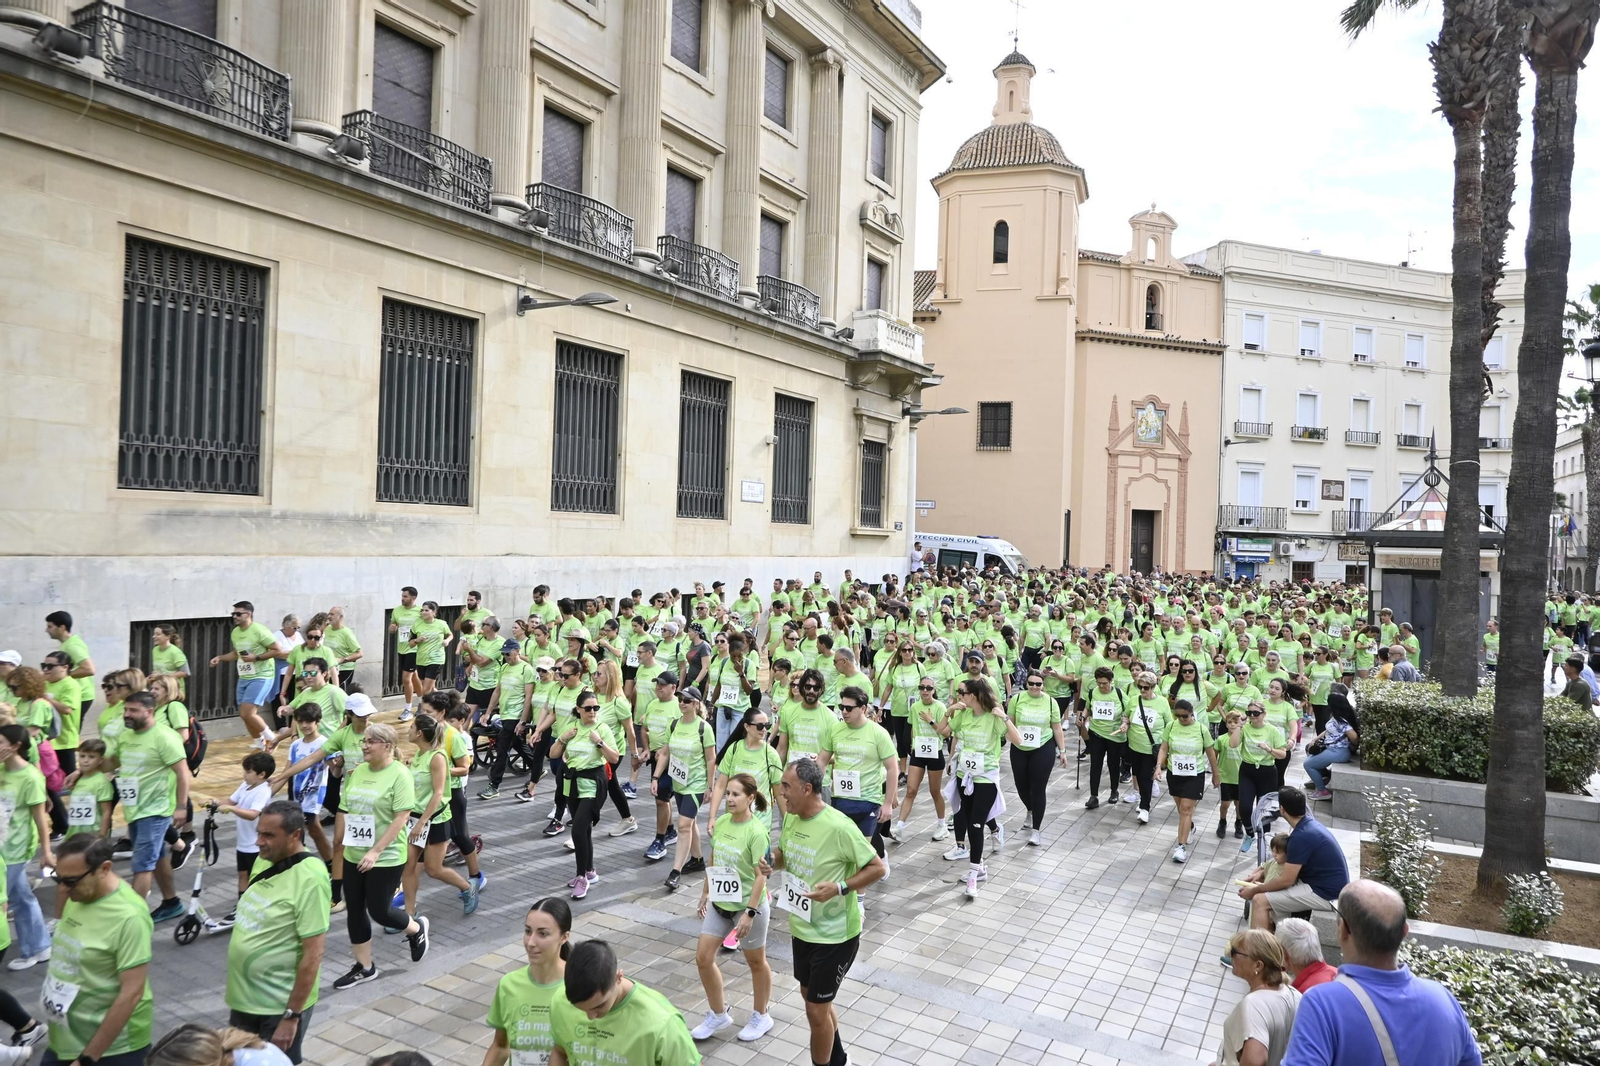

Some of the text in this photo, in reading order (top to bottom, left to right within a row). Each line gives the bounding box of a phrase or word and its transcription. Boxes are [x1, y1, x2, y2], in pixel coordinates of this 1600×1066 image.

[957, 537, 980, 545] CIVIL
[1023, 732, 1035, 742] 99
[920, 744, 932, 753] 95
[965, 759, 977, 770] 92
[840, 779, 854, 791] 98
[69, 807, 93, 818] 252
[518, 1019, 531, 1031] En
[573, 1041, 587, 1054] En
